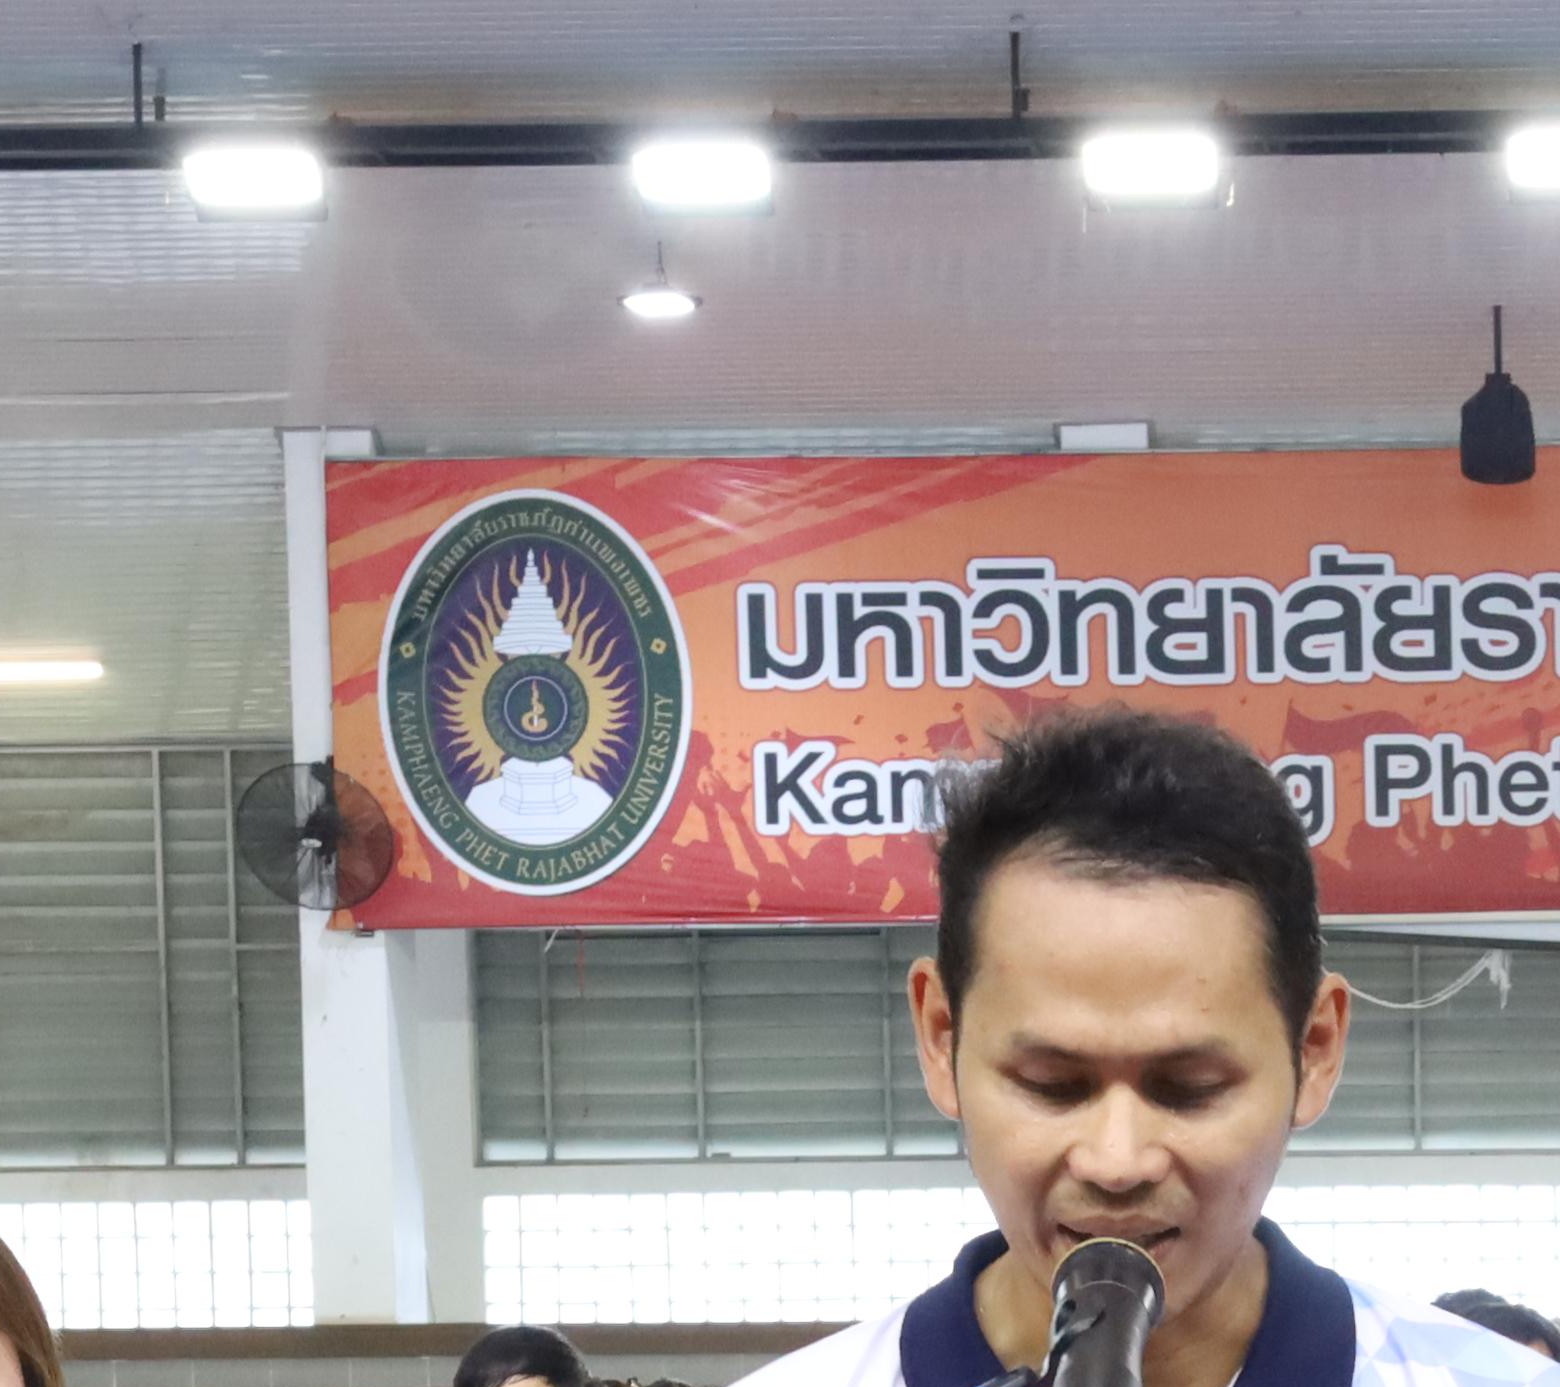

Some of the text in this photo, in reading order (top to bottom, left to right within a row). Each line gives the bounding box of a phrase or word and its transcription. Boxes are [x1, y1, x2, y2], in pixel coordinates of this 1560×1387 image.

[396, 690, 460, 830] KAMPHAENG
[455, 827, 509, 871] PHET
[516, 825, 626, 883] RAJABHAT
[621, 692, 674, 827] UNIVERSITY
